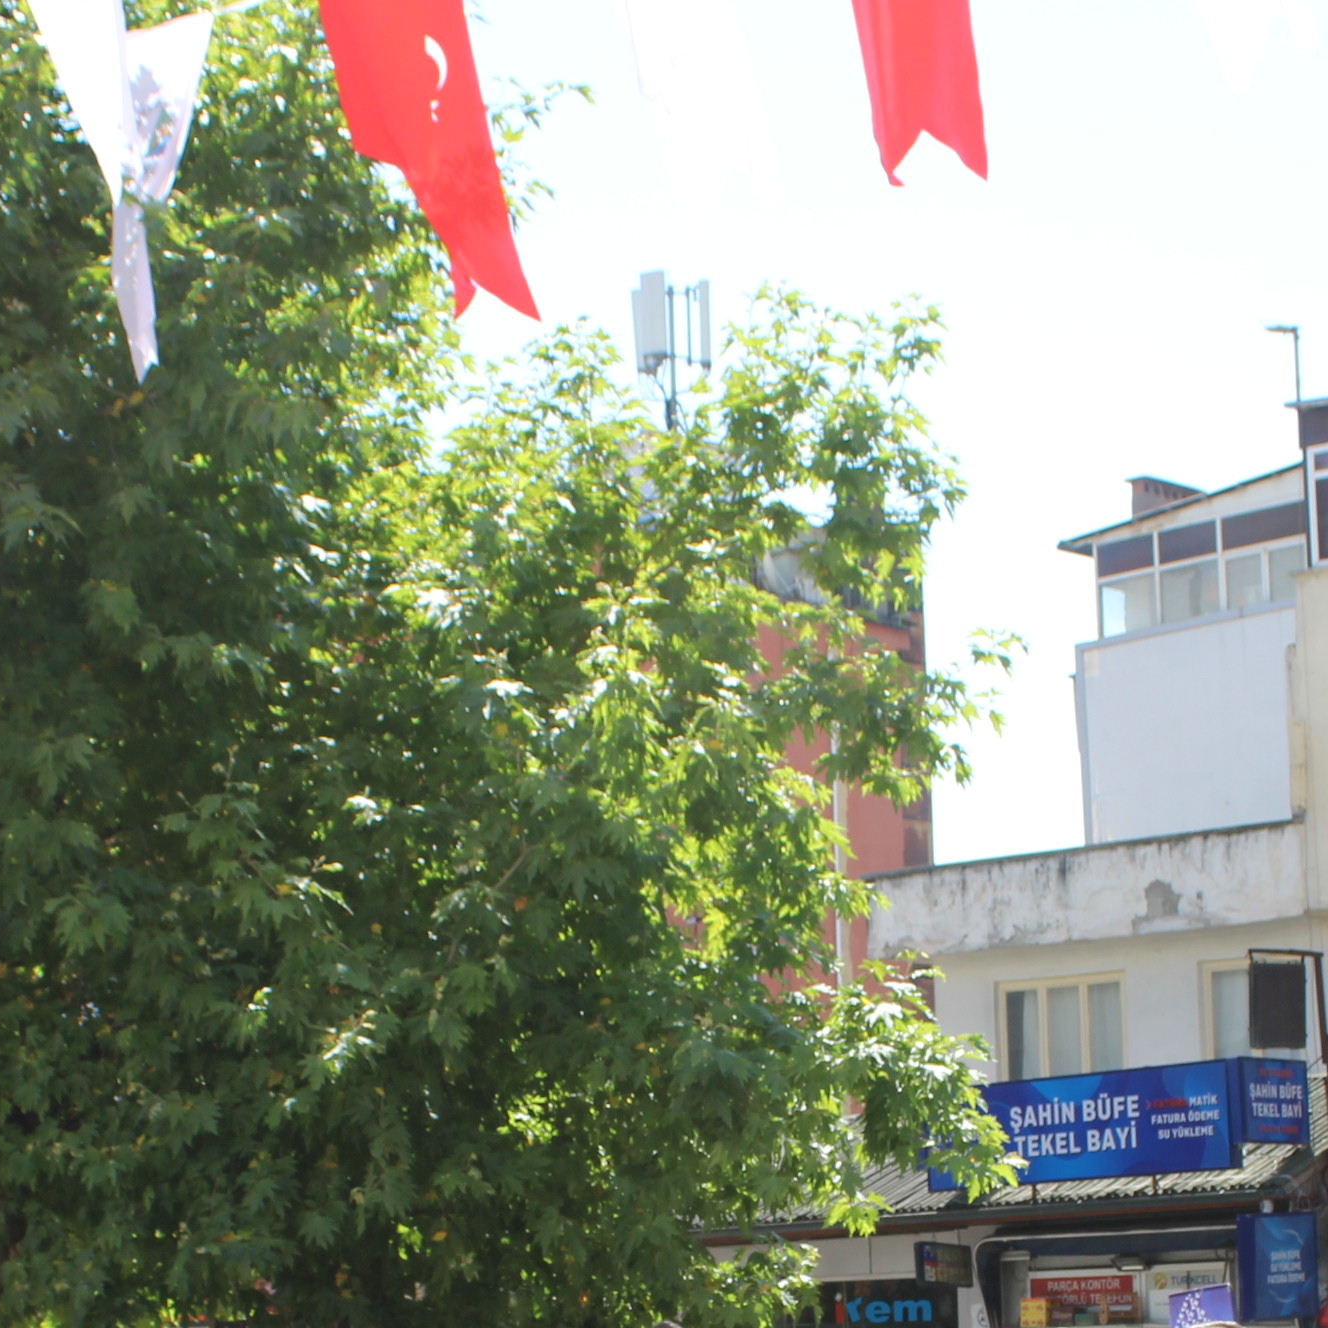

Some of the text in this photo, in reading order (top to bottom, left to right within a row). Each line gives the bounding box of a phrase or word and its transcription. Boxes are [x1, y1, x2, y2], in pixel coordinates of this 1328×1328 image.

[1249, 1080, 1303, 1102] ŞAHİN BÜFE
[1009, 1093, 1141, 1131] ŞAHİN BÜFE
[1151, 1109, 1221, 1126] FATURA ÖDEME
[1252, 1101, 1303, 1118] TEKEL BAYİ
[1013, 1120, 1139, 1159] TEKEL BAYİ
[1158, 1125, 1215, 1140] SU YÜKLEME
[1047, 1275, 1121, 1293] PARÇA KONTÖR
